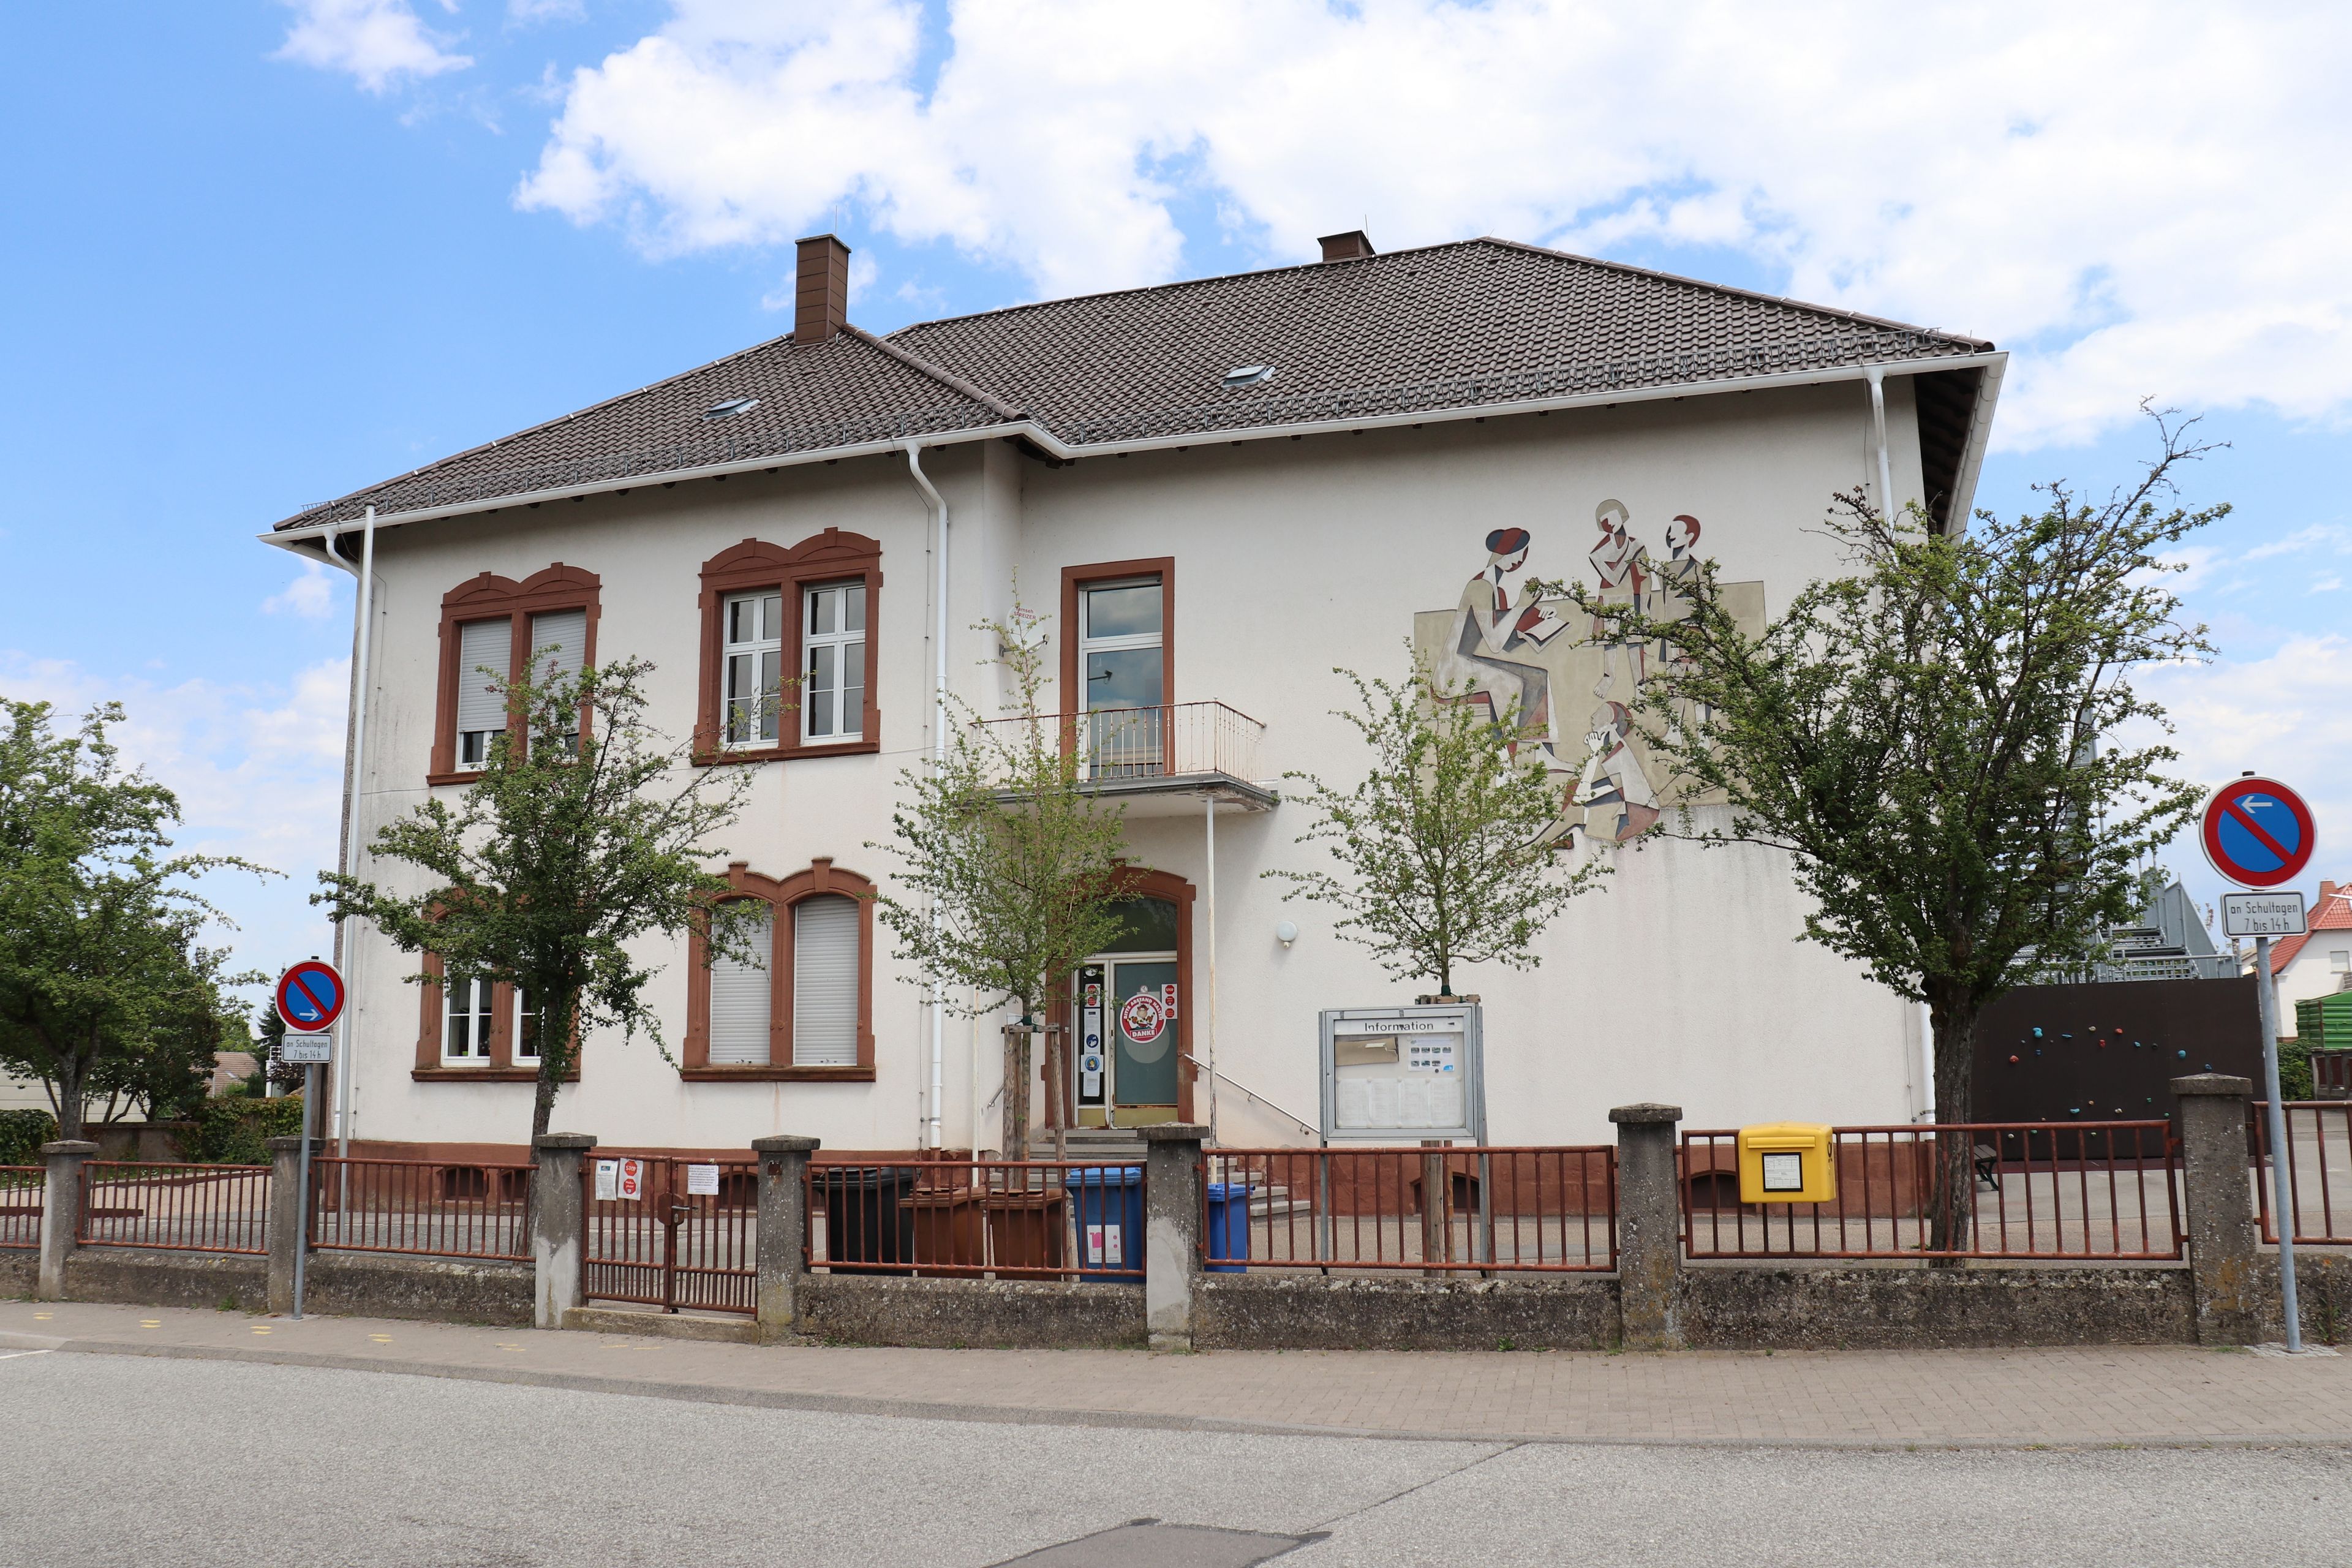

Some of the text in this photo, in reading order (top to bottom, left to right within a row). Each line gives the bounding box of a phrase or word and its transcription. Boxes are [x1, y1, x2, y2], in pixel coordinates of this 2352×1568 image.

[2245, 901, 2298, 916] Schultagen
[2244, 918, 2250, 931] 7
[2253, 918, 2267, 932] bis
[1130, 997, 1153, 1006] ABSTAND
[1152, 1001, 1163, 1020] HALT
[1365, 1021, 1434, 1031] Information
[296, 1039, 328, 1049] Schultagen
[294, 1050, 298, 1059] 7
[299, 1049, 307, 1059] bis
